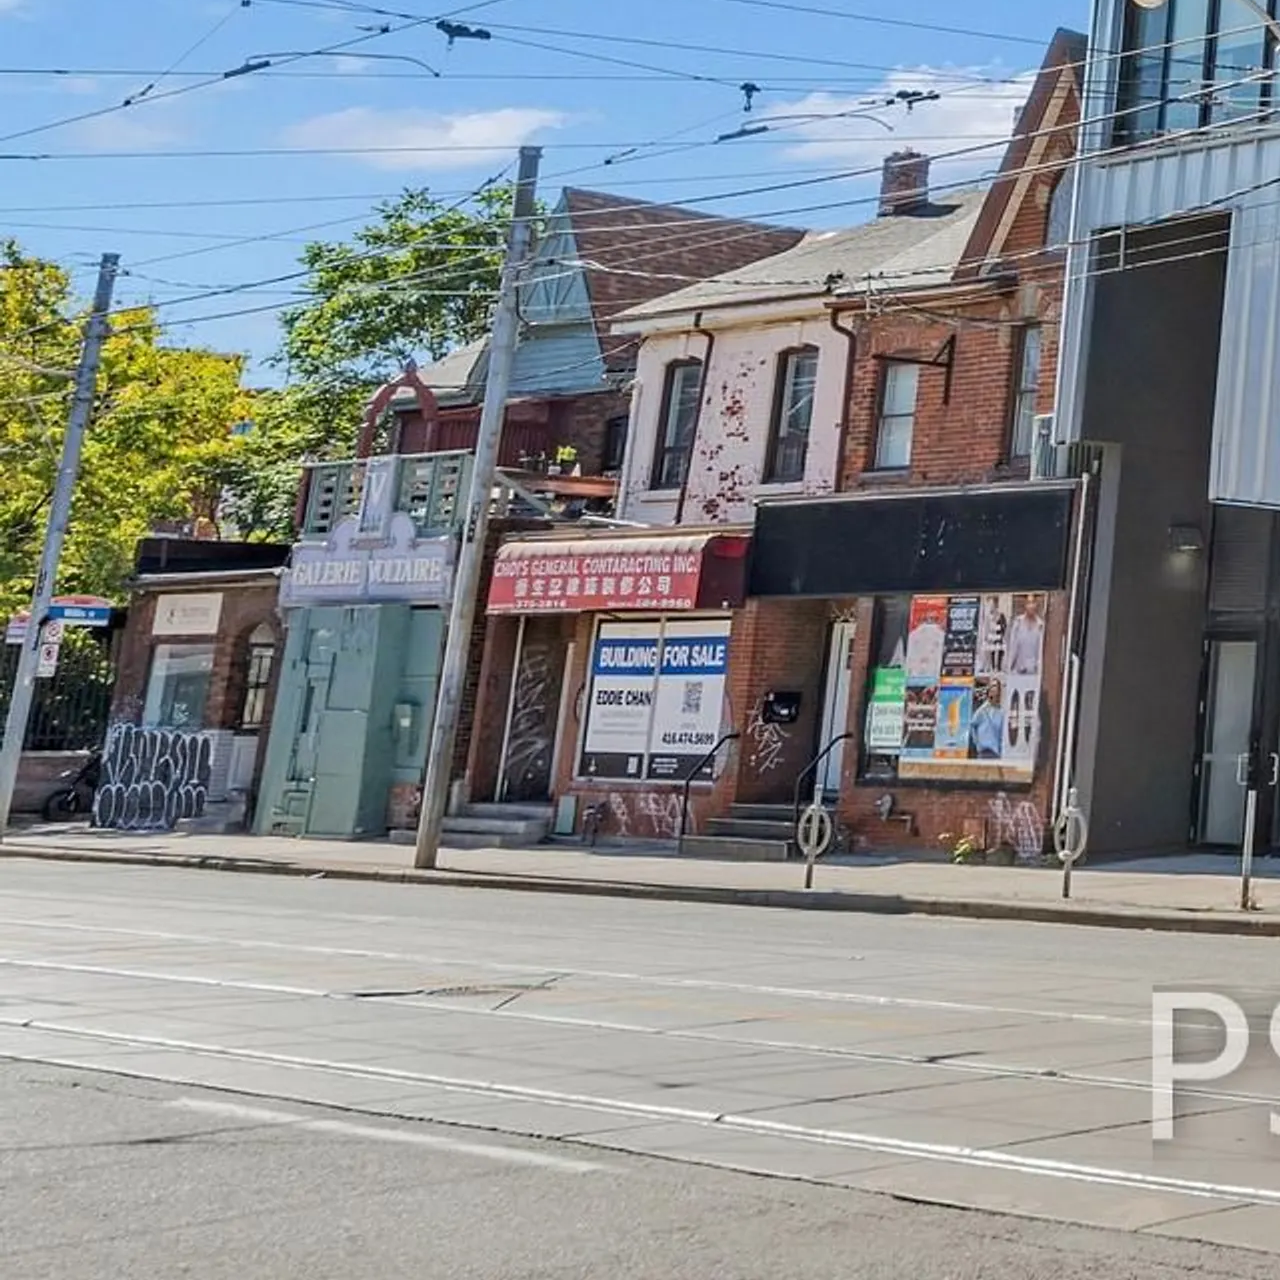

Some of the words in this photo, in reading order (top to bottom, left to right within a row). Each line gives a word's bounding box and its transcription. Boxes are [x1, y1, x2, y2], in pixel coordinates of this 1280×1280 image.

[292, 560, 361, 586] GALERIE
[367, 558, 442, 583] VOLTAIRE
[494, 561, 529, 577] CHOI'S
[531, 559, 579, 576] GENERAL
[673, 556, 698, 574] INC.
[600, 645, 657, 668] BUILDING
[662, 645, 689, 667] FOR
[690, 644, 726, 667] SALE
[596, 689, 624, 705] EDDIE
[625, 689, 653, 706] CHAN
